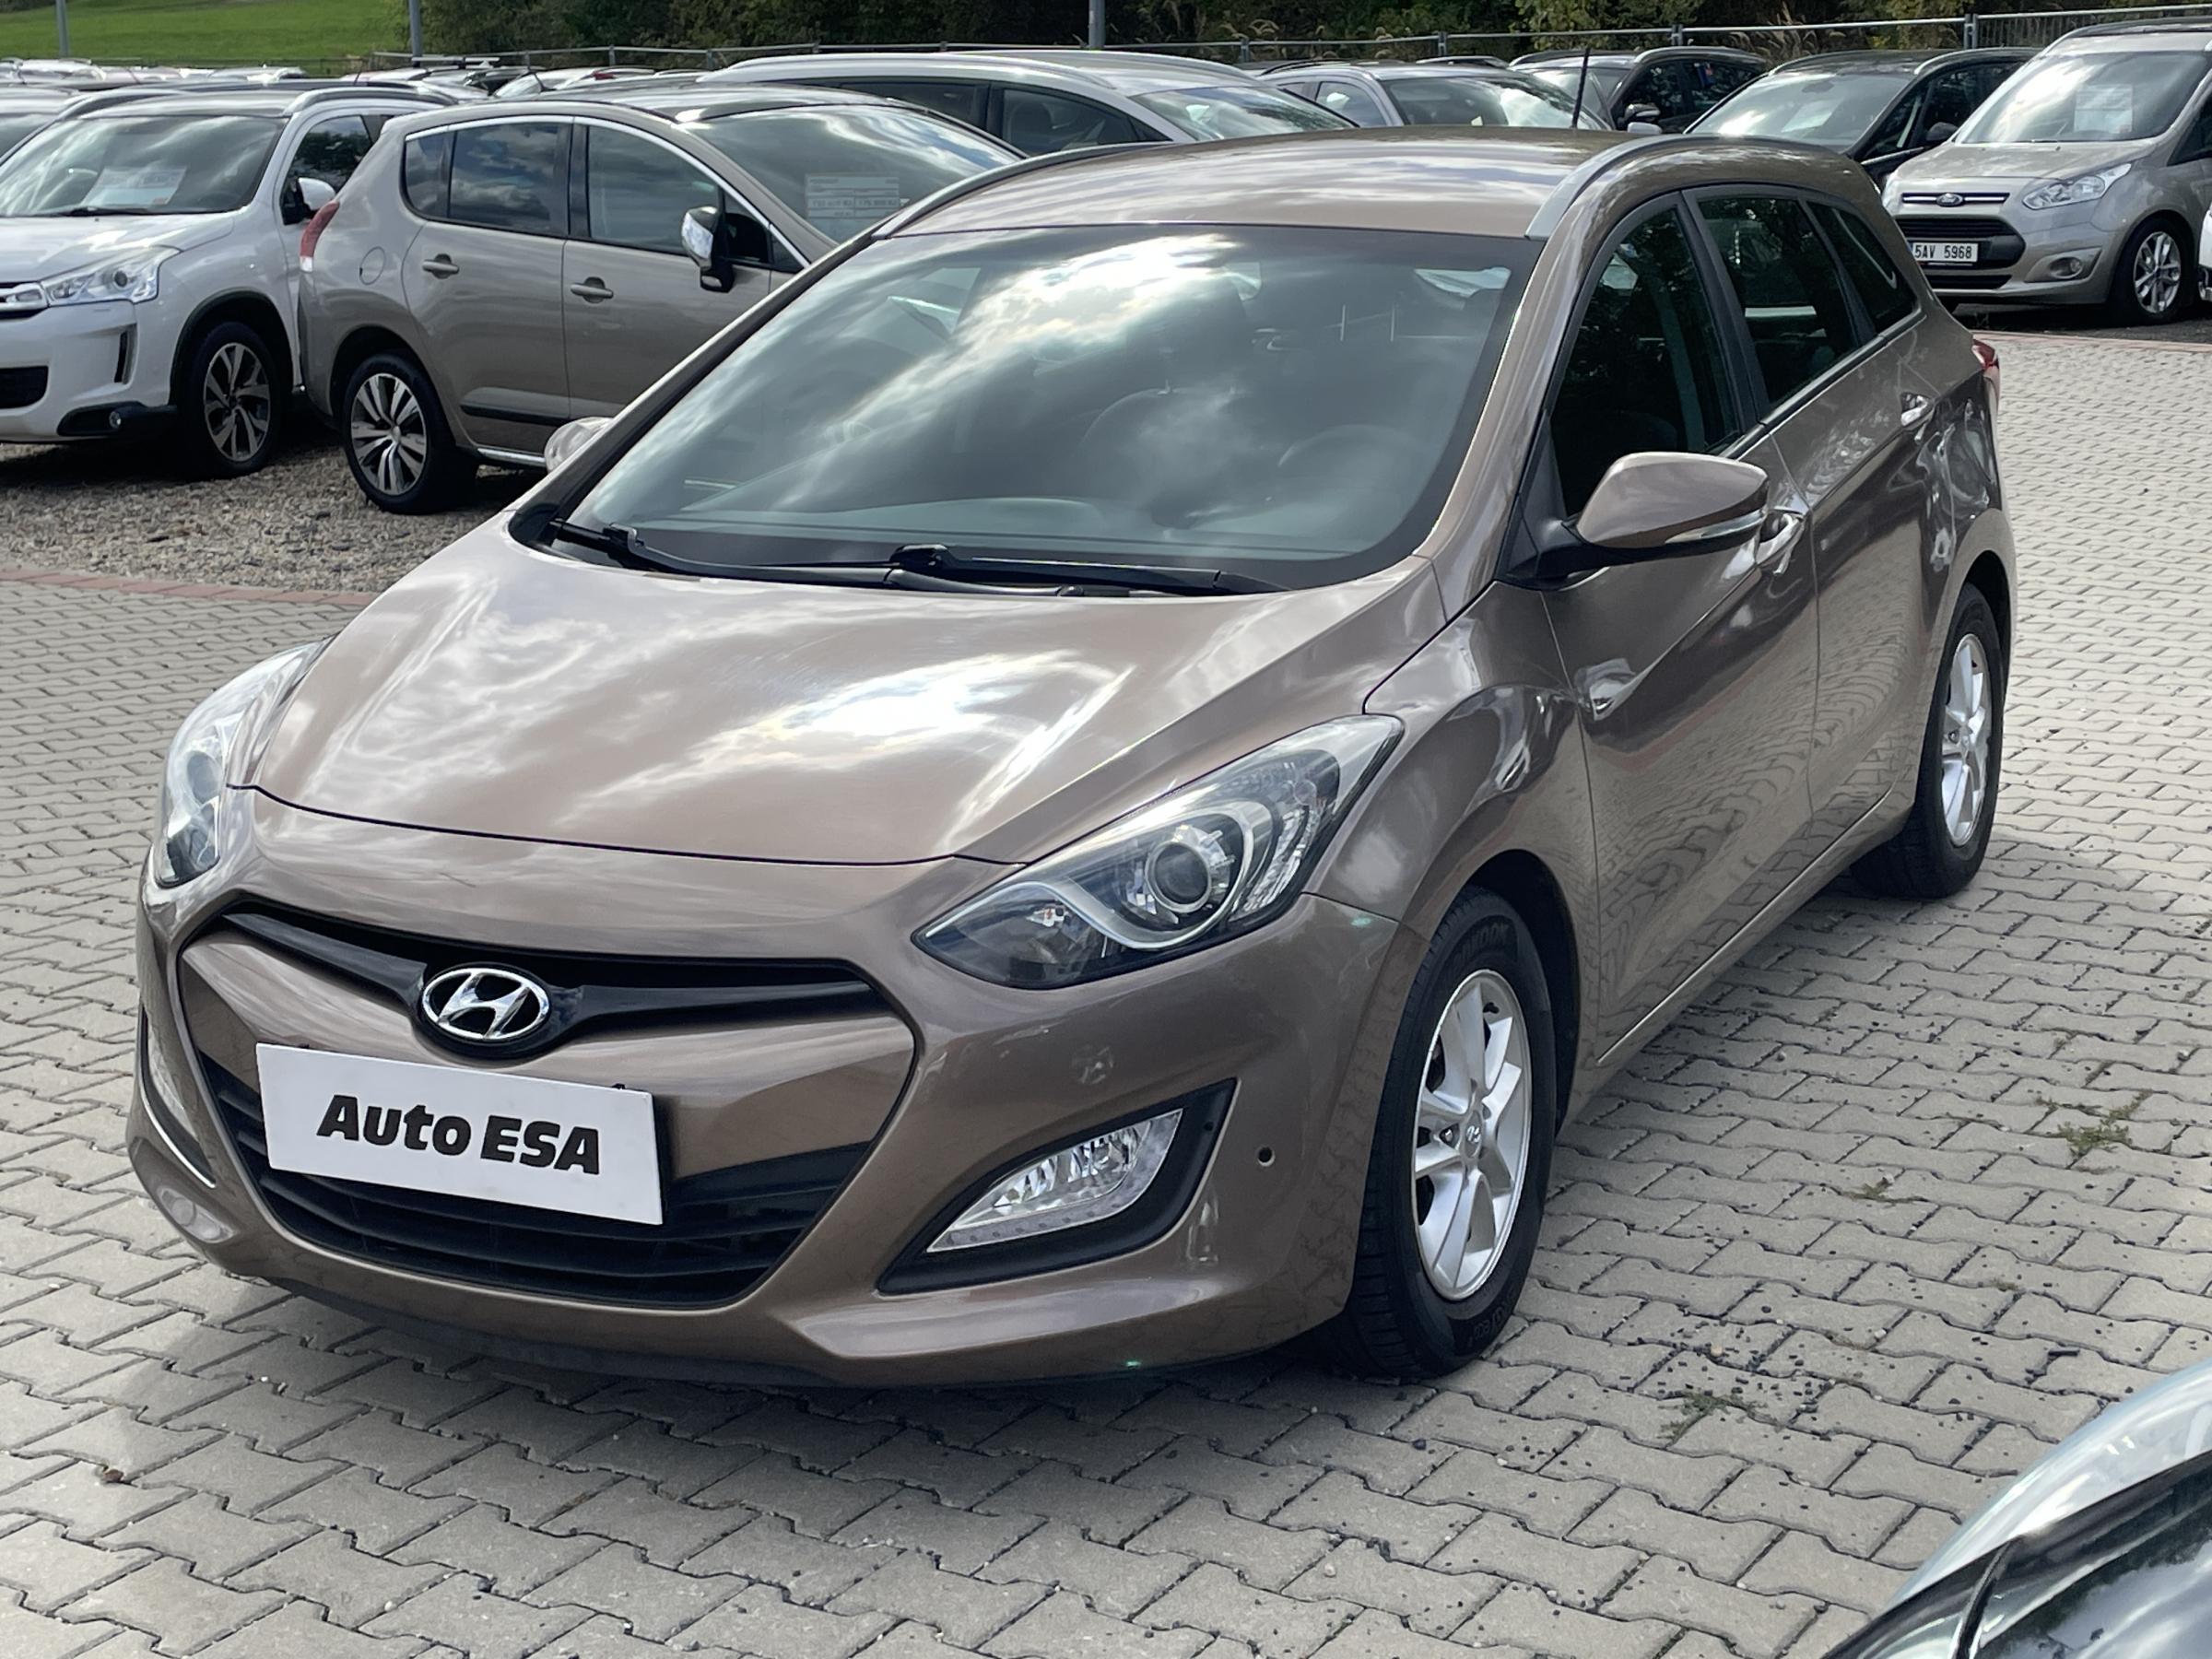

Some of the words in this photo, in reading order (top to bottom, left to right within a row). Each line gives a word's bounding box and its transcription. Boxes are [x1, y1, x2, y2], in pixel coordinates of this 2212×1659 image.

[1914, 244, 1936, 259] 5AV
[1944, 245, 1972, 260] 5968
[316, 1094, 472, 1156] Auto
[480, 1114, 600, 1175] ESA
